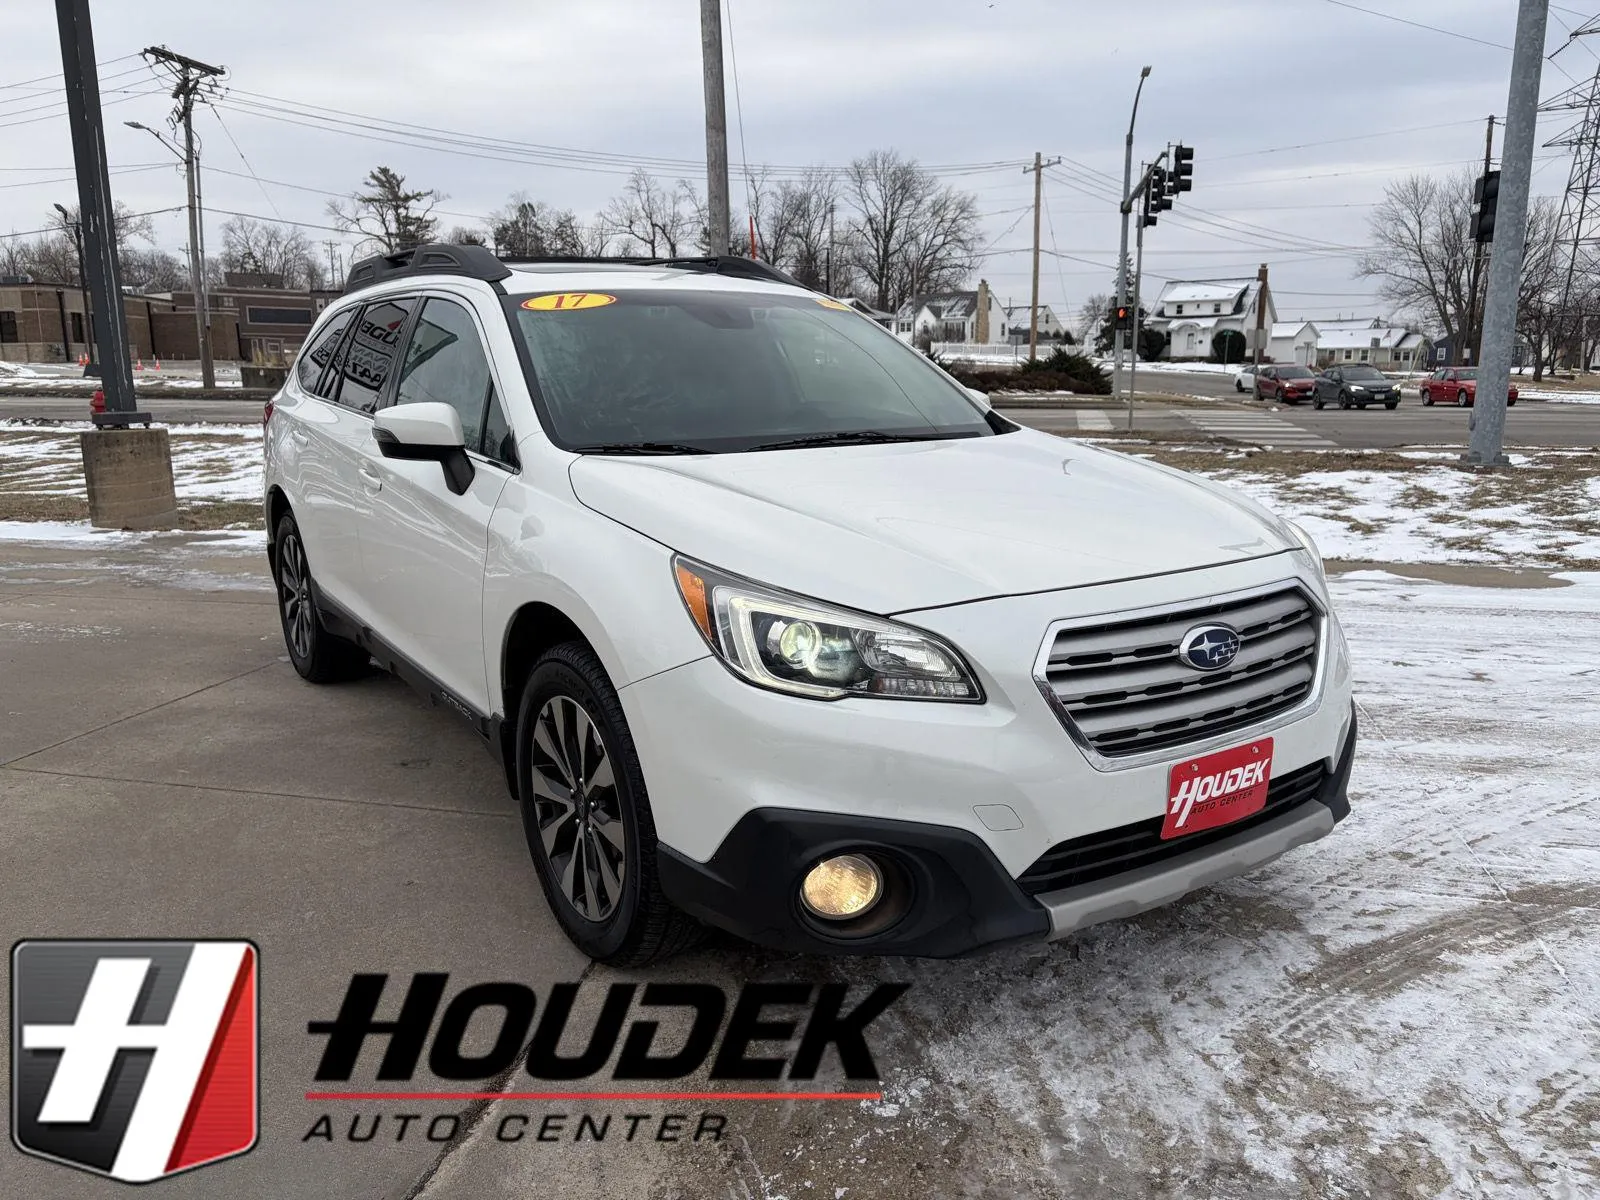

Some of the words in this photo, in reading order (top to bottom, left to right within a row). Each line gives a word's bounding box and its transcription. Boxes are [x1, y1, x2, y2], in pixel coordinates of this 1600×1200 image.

[555, 294, 587, 308] 17
[1170, 758, 1270, 828] HOUDEK
[1190, 803, 1216, 815] AUTO
[1220, 790, 1253, 807] CENTER
